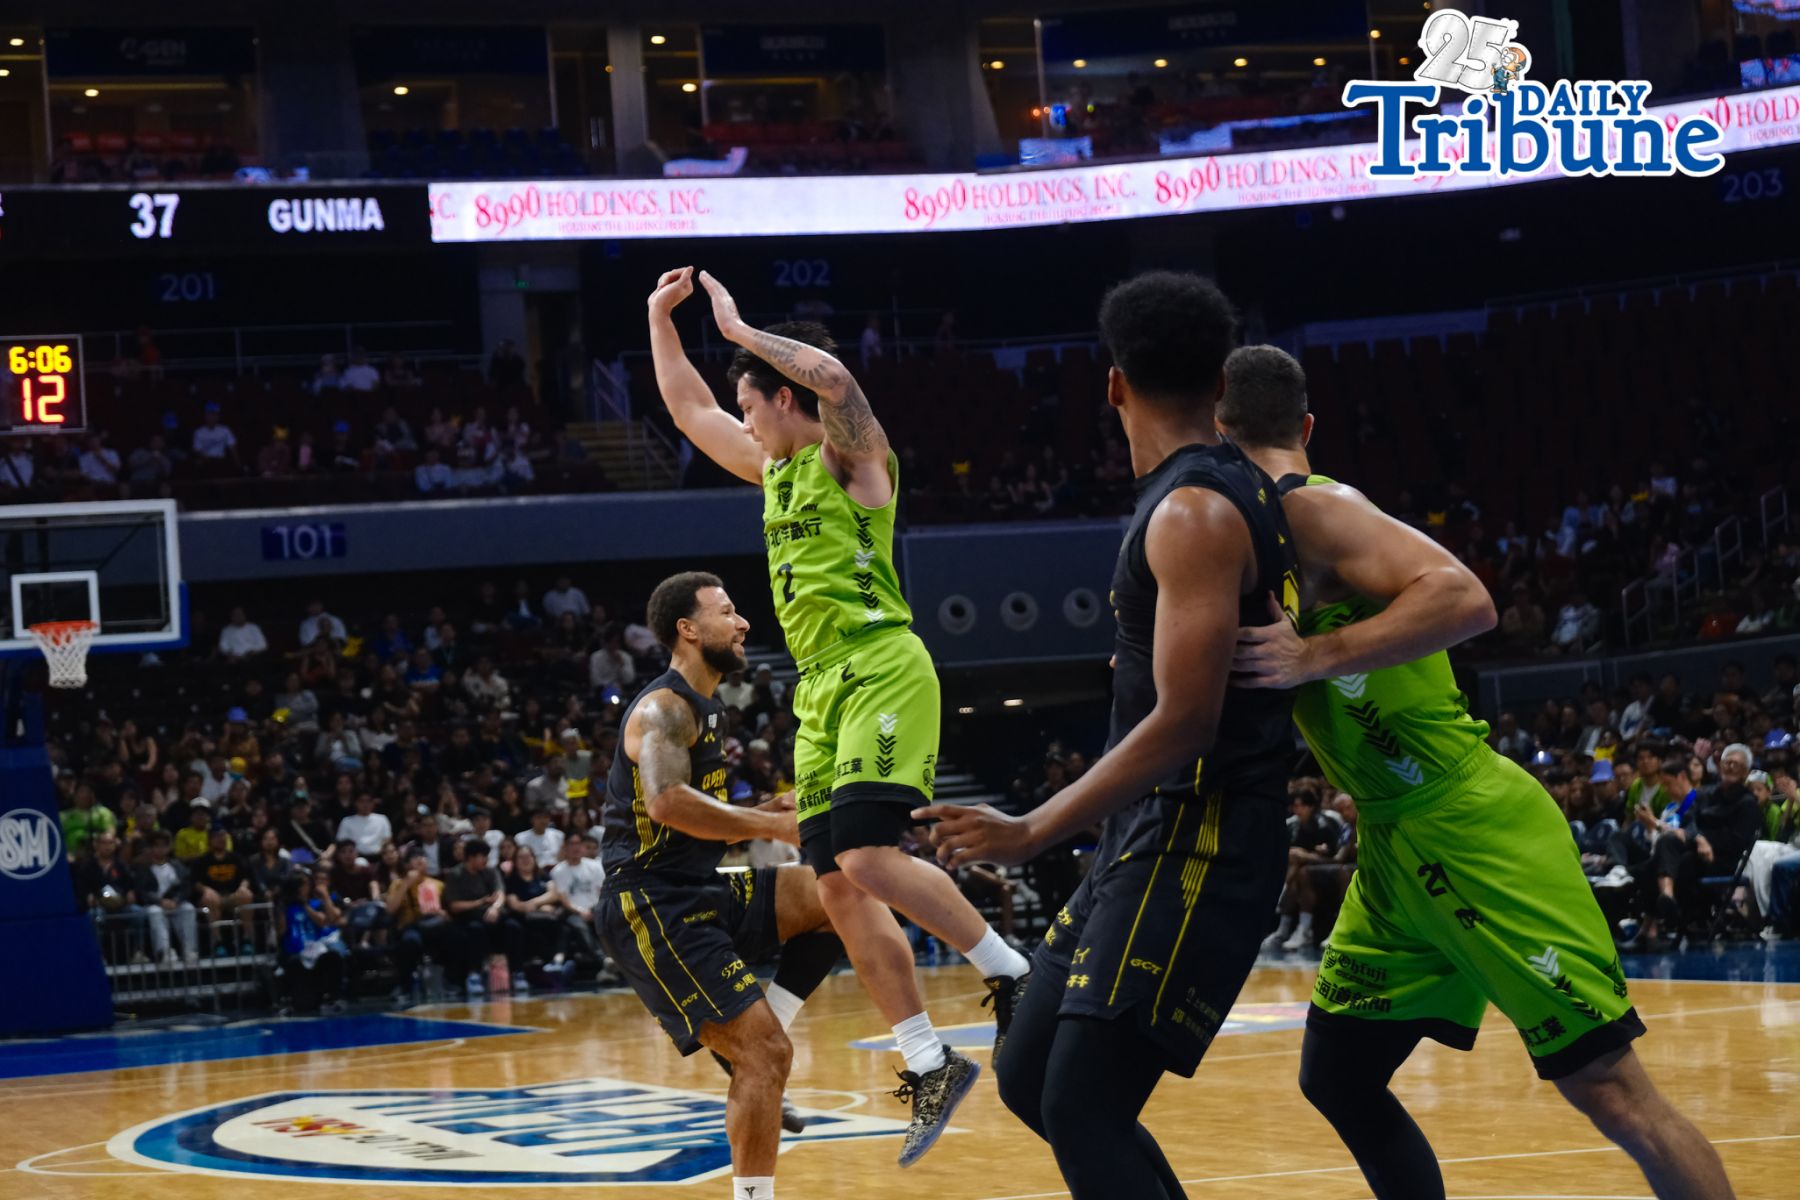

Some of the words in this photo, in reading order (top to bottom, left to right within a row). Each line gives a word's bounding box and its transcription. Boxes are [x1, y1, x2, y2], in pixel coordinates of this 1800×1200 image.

[904, 178, 967, 228] 8990
[972, 176, 1089, 210] HOLDINGS,
[1093, 171, 1137, 200] INC.
[1154, 156, 1220, 211] 8990
[1226, 156, 1345, 189] HOLDINGS,
[1723, 168, 1783, 202] 203
[129, 193, 179, 239] 37
[268, 197, 385, 233] GUNMA
[474, 184, 541, 235] 8990
[547, 190, 663, 219] HOLDINGS,
[669, 188, 712, 216] INC.
[160, 272, 215, 302] 201
[773, 259, 832, 287] 202
[9, 345, 72, 375] 6:06
[23, 375, 65, 423] 12
[272, 524, 332, 560] 101
[777, 562, 796, 603] 2
[0, 818, 50, 872] SM
